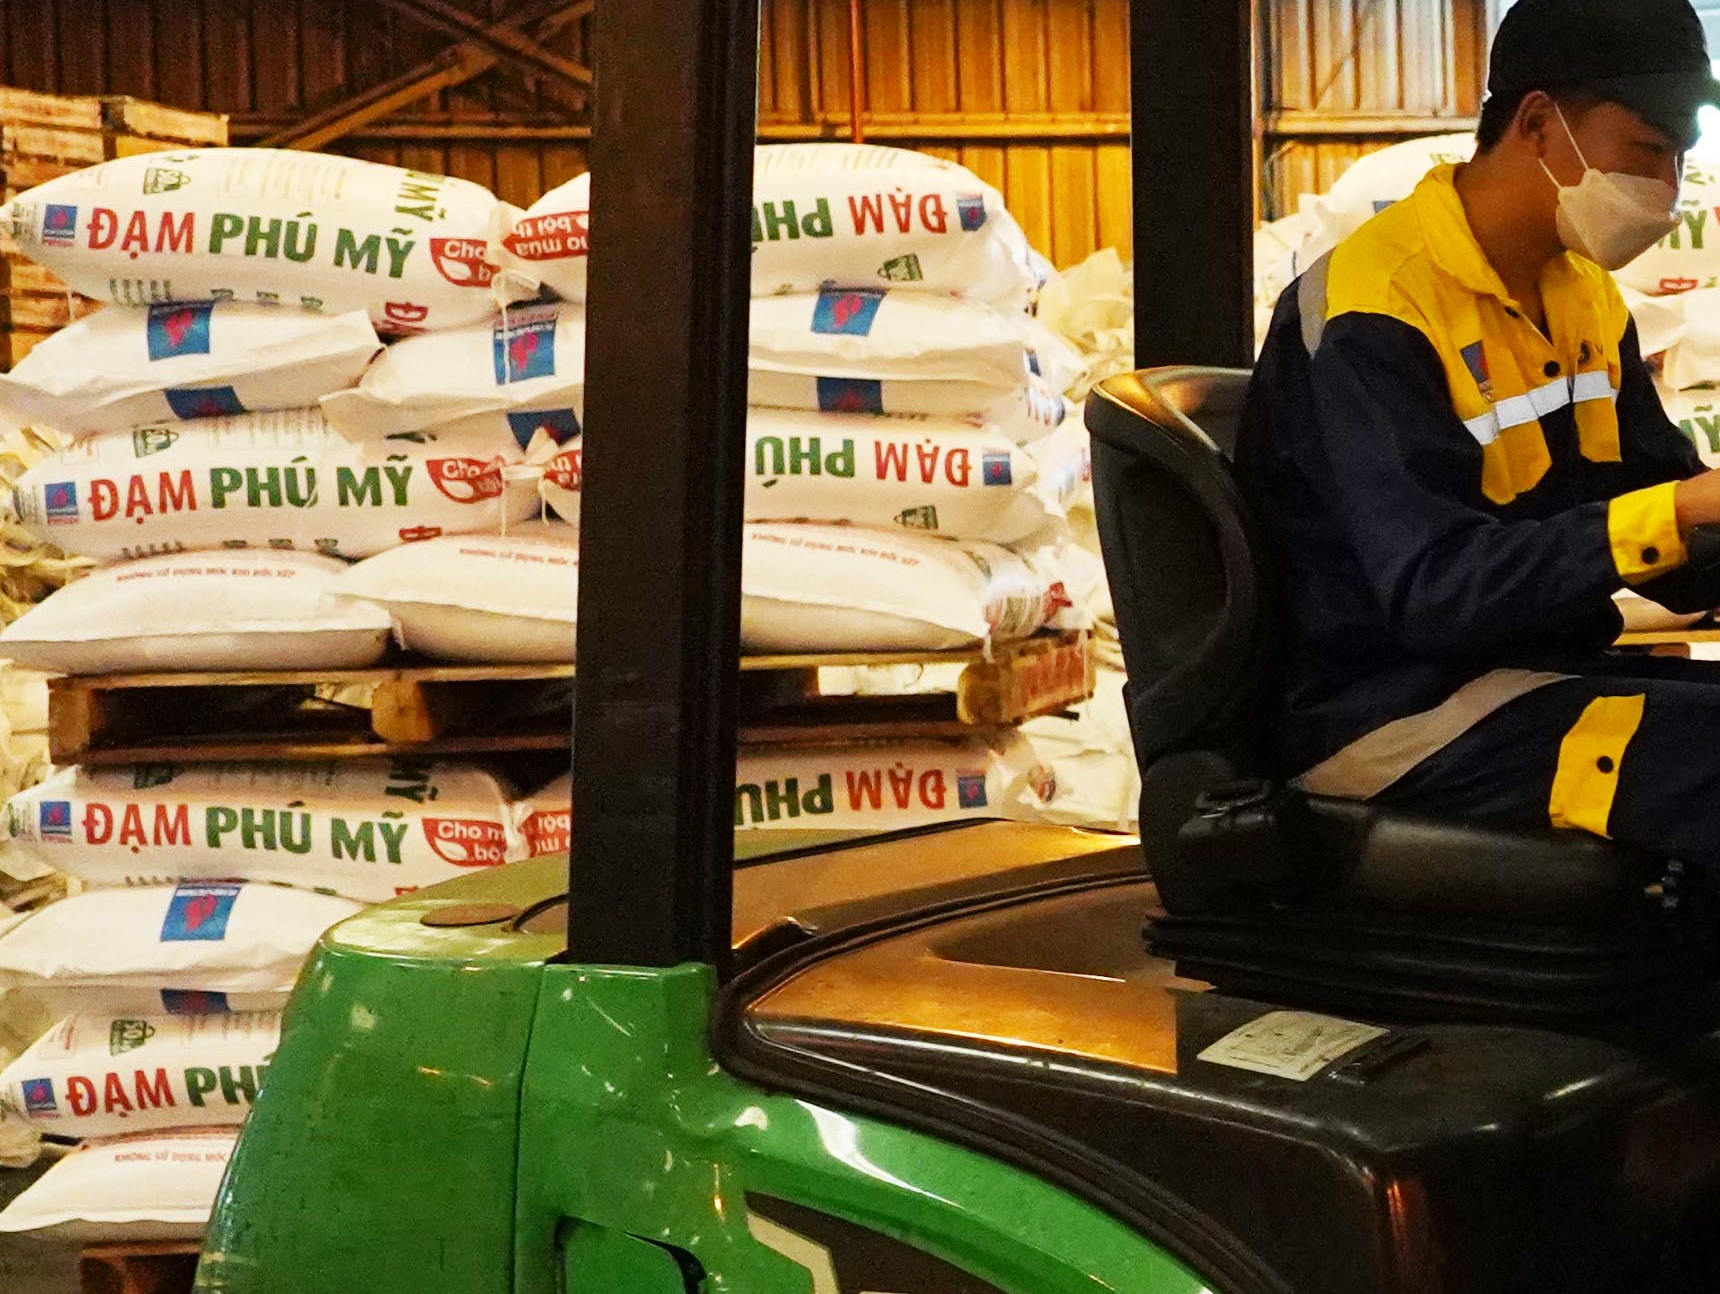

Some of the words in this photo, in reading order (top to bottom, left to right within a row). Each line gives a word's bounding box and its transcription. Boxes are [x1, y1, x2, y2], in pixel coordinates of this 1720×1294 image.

[848, 193, 948, 236] ĐẠM
[86, 207, 195, 261] ĐẠM
[208, 211, 318, 264] PHÚ
[333, 227, 416, 279] MỸ
[87, 469, 198, 523] ĐẠM
[209, 455, 319, 510] PHÚ
[336, 453, 413, 507] MỸ
[755, 436, 856, 489] PHÚ
[874, 438, 972, 488] ĐẠM
[844, 760, 947, 811] ĐẠM
[81, 802, 192, 855] ĐẠM
[205, 806, 312, 855] PHÚ
[330, 810, 408, 865] MỸ
[438, 821, 482, 842] Cho
[64, 1068, 178, 1119] ĐẠM
